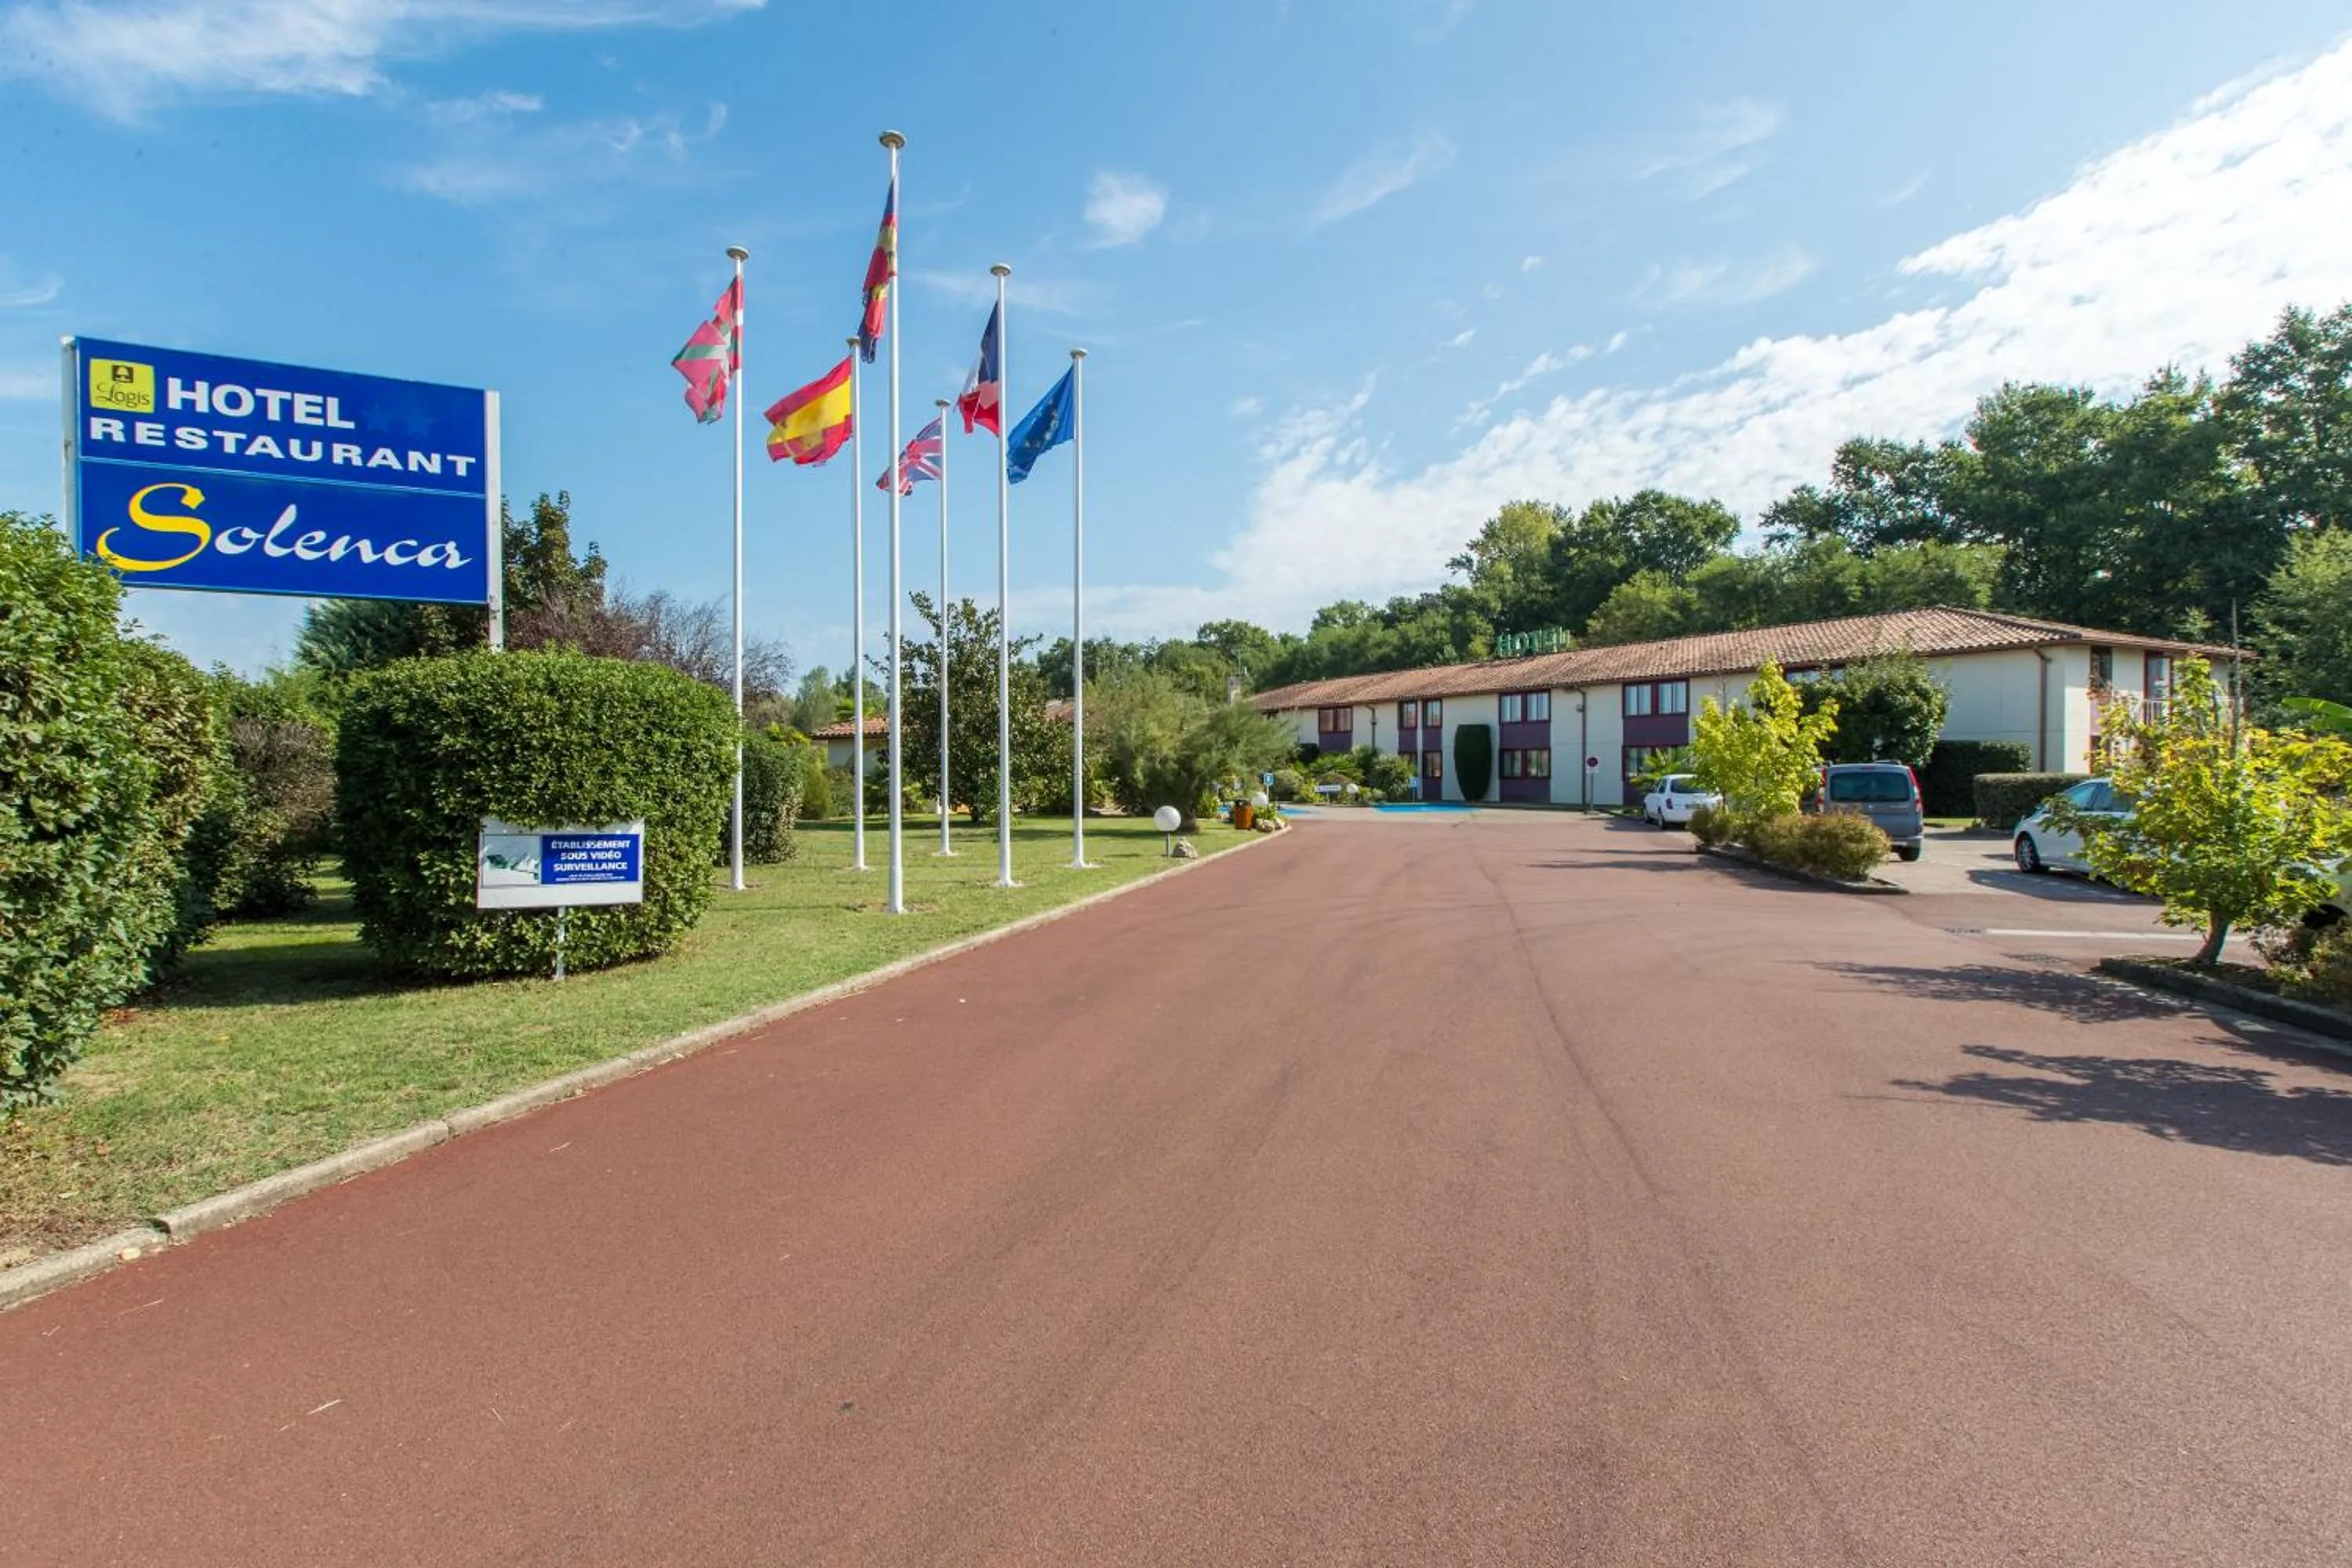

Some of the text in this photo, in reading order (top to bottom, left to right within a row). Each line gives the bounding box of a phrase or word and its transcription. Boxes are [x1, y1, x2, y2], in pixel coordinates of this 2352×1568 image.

[96, 382, 151, 408] Logis
[167, 377, 354, 429] HOTEL
[89, 416, 476, 477] RESTAURANT
[96, 482, 471, 572] Solenca
[551, 840, 631, 848] ÉTABLISSEMENT
[561, 850, 622, 860] SOUS VIDÉO
[554, 862, 627, 871] SURVEILLANCE
